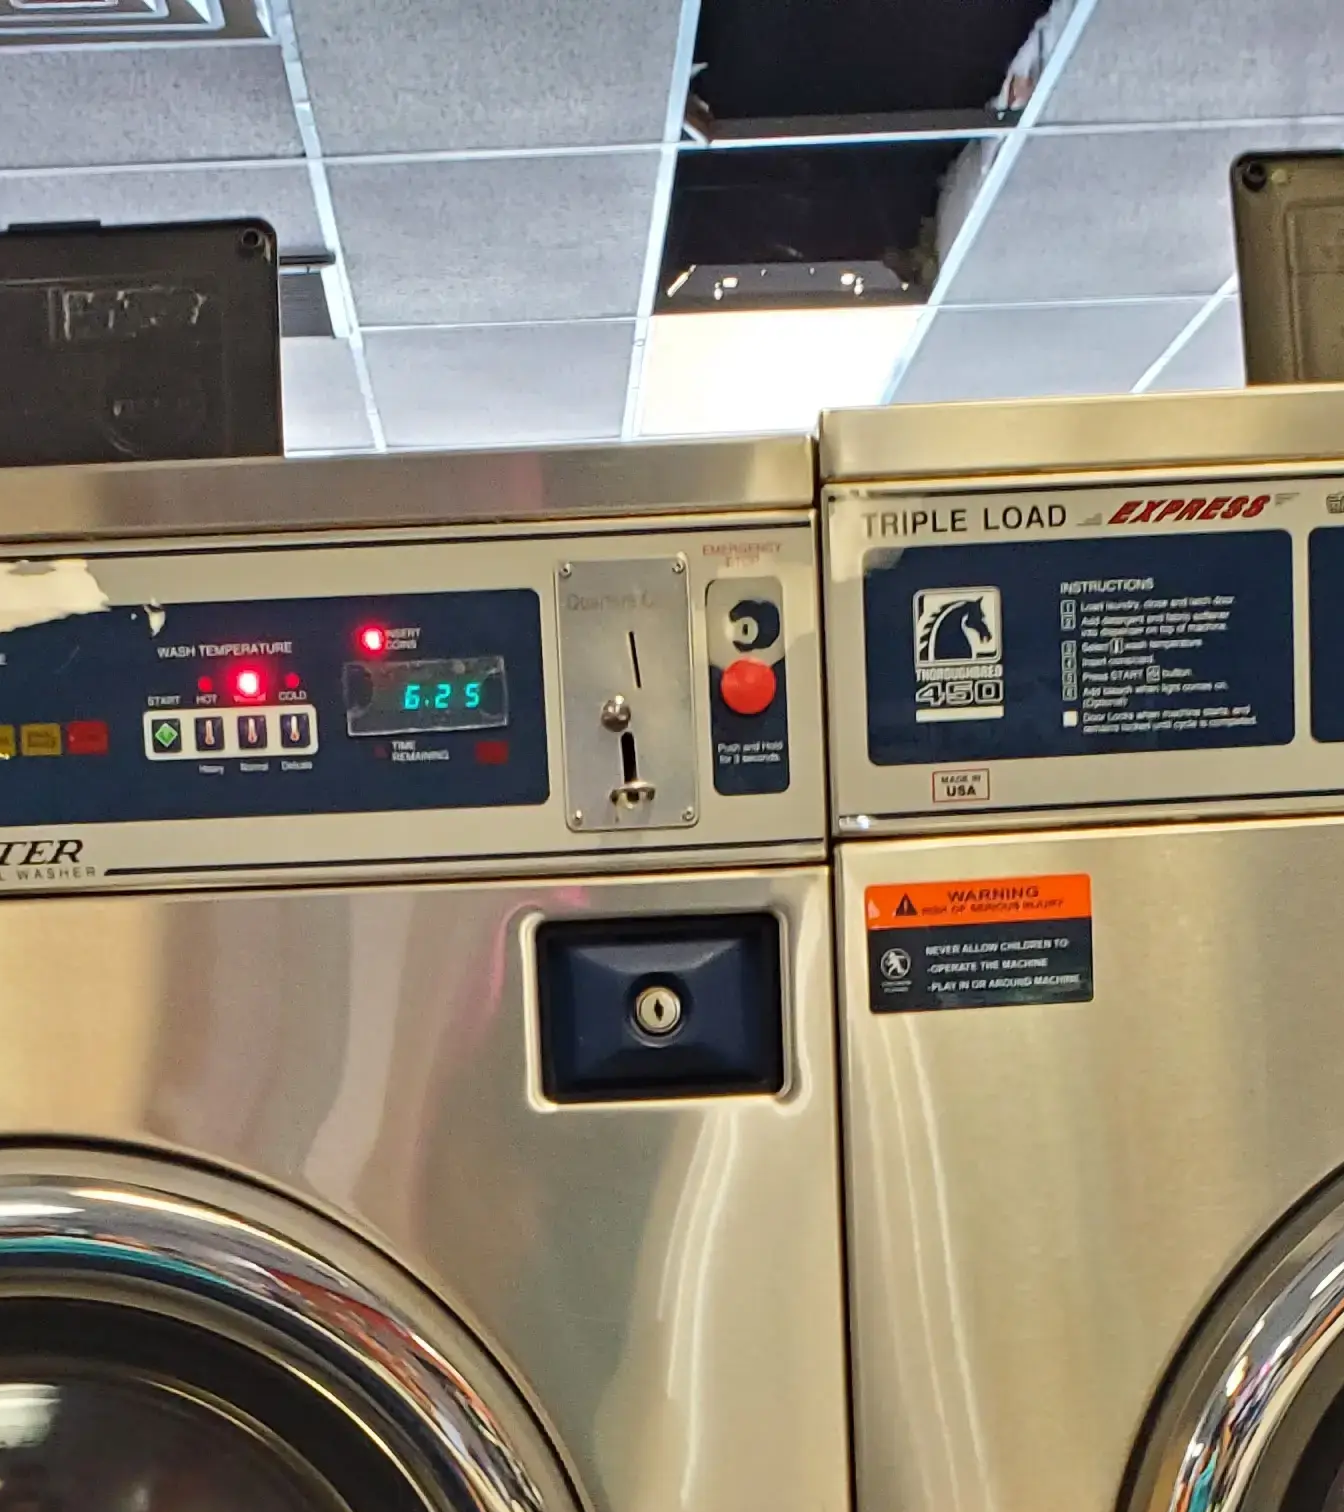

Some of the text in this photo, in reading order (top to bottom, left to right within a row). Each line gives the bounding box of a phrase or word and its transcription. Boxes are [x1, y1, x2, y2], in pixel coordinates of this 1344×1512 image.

[861, 494, 1271, 538] TRIPLE LOAD EXPRESS
[1060, 578, 1154, 595] INSTRUCTIONS
[385, 628, 420, 639] NSERT
[158, 642, 292, 658] WASH TEMPERATURE
[196, 693, 218, 704] HOT
[278, 691, 306, 701] COLD
[404, 683, 480, 709] 6.25
[916, 680, 1003, 706] 450
[148, 695, 181, 706] START
[392, 740, 416, 751] TIME
[392, 750, 449, 761] REMAINING
[947, 786, 976, 796] USA
[17, 867, 96, 880] WASHER
[947, 886, 1038, 902] WARNING
[926, 938, 1069, 956] NEVER ALLOW CHILDREN TO
[980, 960, 999, 971] THE
[1002, 958, 1048, 969] MACHINE
[959, 981, 970, 990] IN
[971, 980, 986, 989] OR
[989, 977, 1032, 988] AROUND
